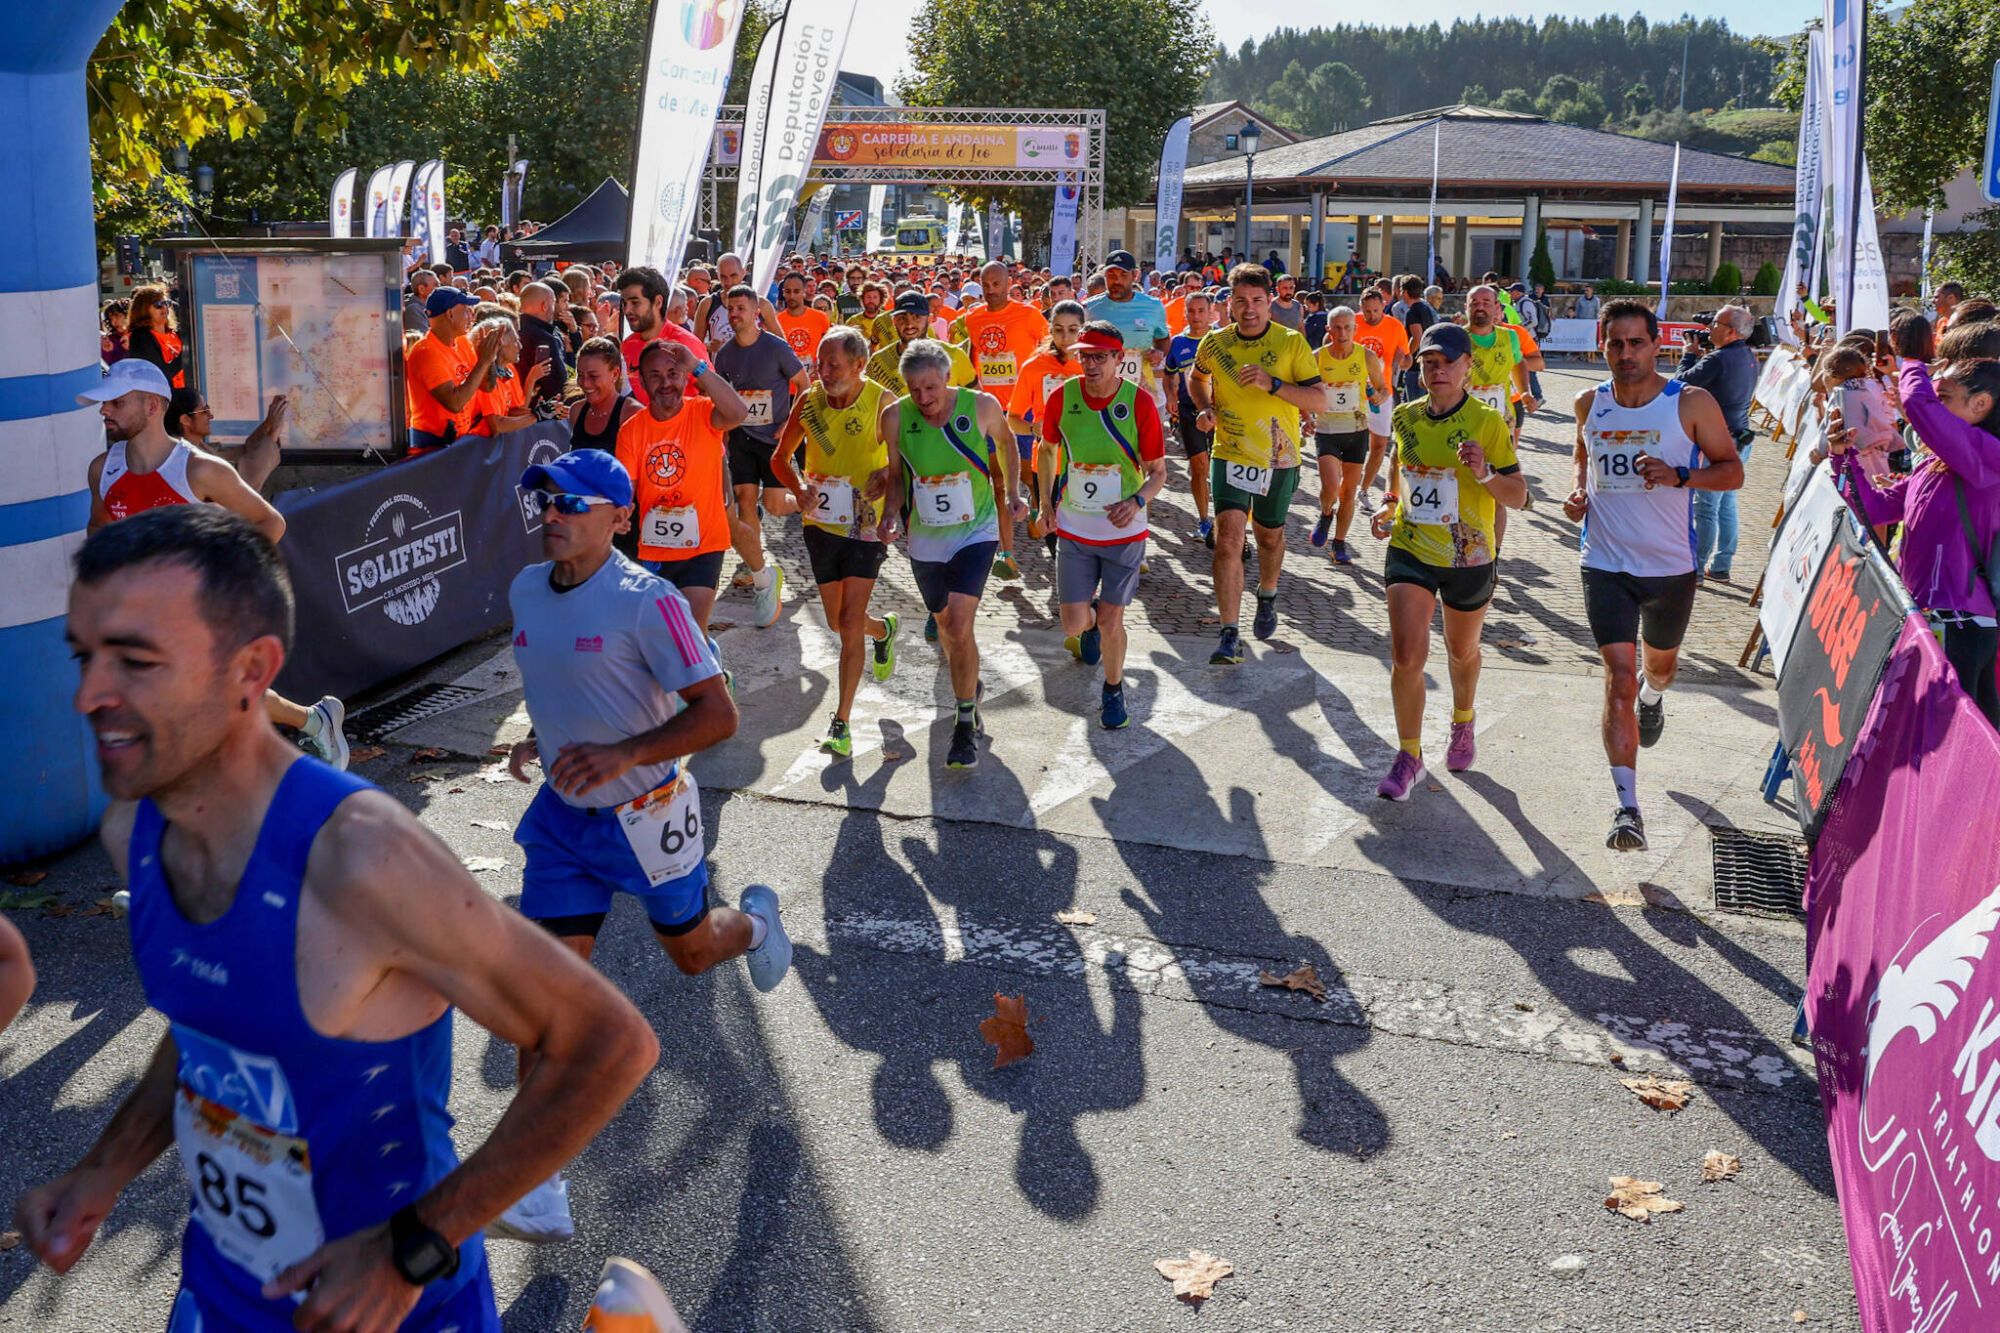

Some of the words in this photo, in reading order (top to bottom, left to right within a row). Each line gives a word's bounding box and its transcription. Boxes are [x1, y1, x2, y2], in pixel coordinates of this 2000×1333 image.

[780, 24, 815, 161] Deputación
[747, 83, 770, 183] Deputación
[862, 132, 928, 145] CARREIRA
[931, 133, 939, 145] E
[943, 133, 1006, 146] ANDAINA
[873, 142, 942, 161] solidaria
[945, 142, 966, 160] de
[968, 143, 992, 163] Leo
[983, 363, 1014, 375] 2601
[1336, 393, 1346, 405] 3
[748, 402, 768, 417] 47
[1233, 464, 1268, 484] 201
[1083, 482, 1098, 499] 9
[1410, 485, 1441, 509] 64
[818, 492, 830, 511] 2
[936, 494, 950, 513] 5
[654, 520, 684, 538] 59
[347, 526, 458, 596] SOLIFESTI
[660, 803, 699, 855] 66
[196, 1151, 276, 1239] 85
[1929, 1091, 2000, 1287] TRIATHLON
